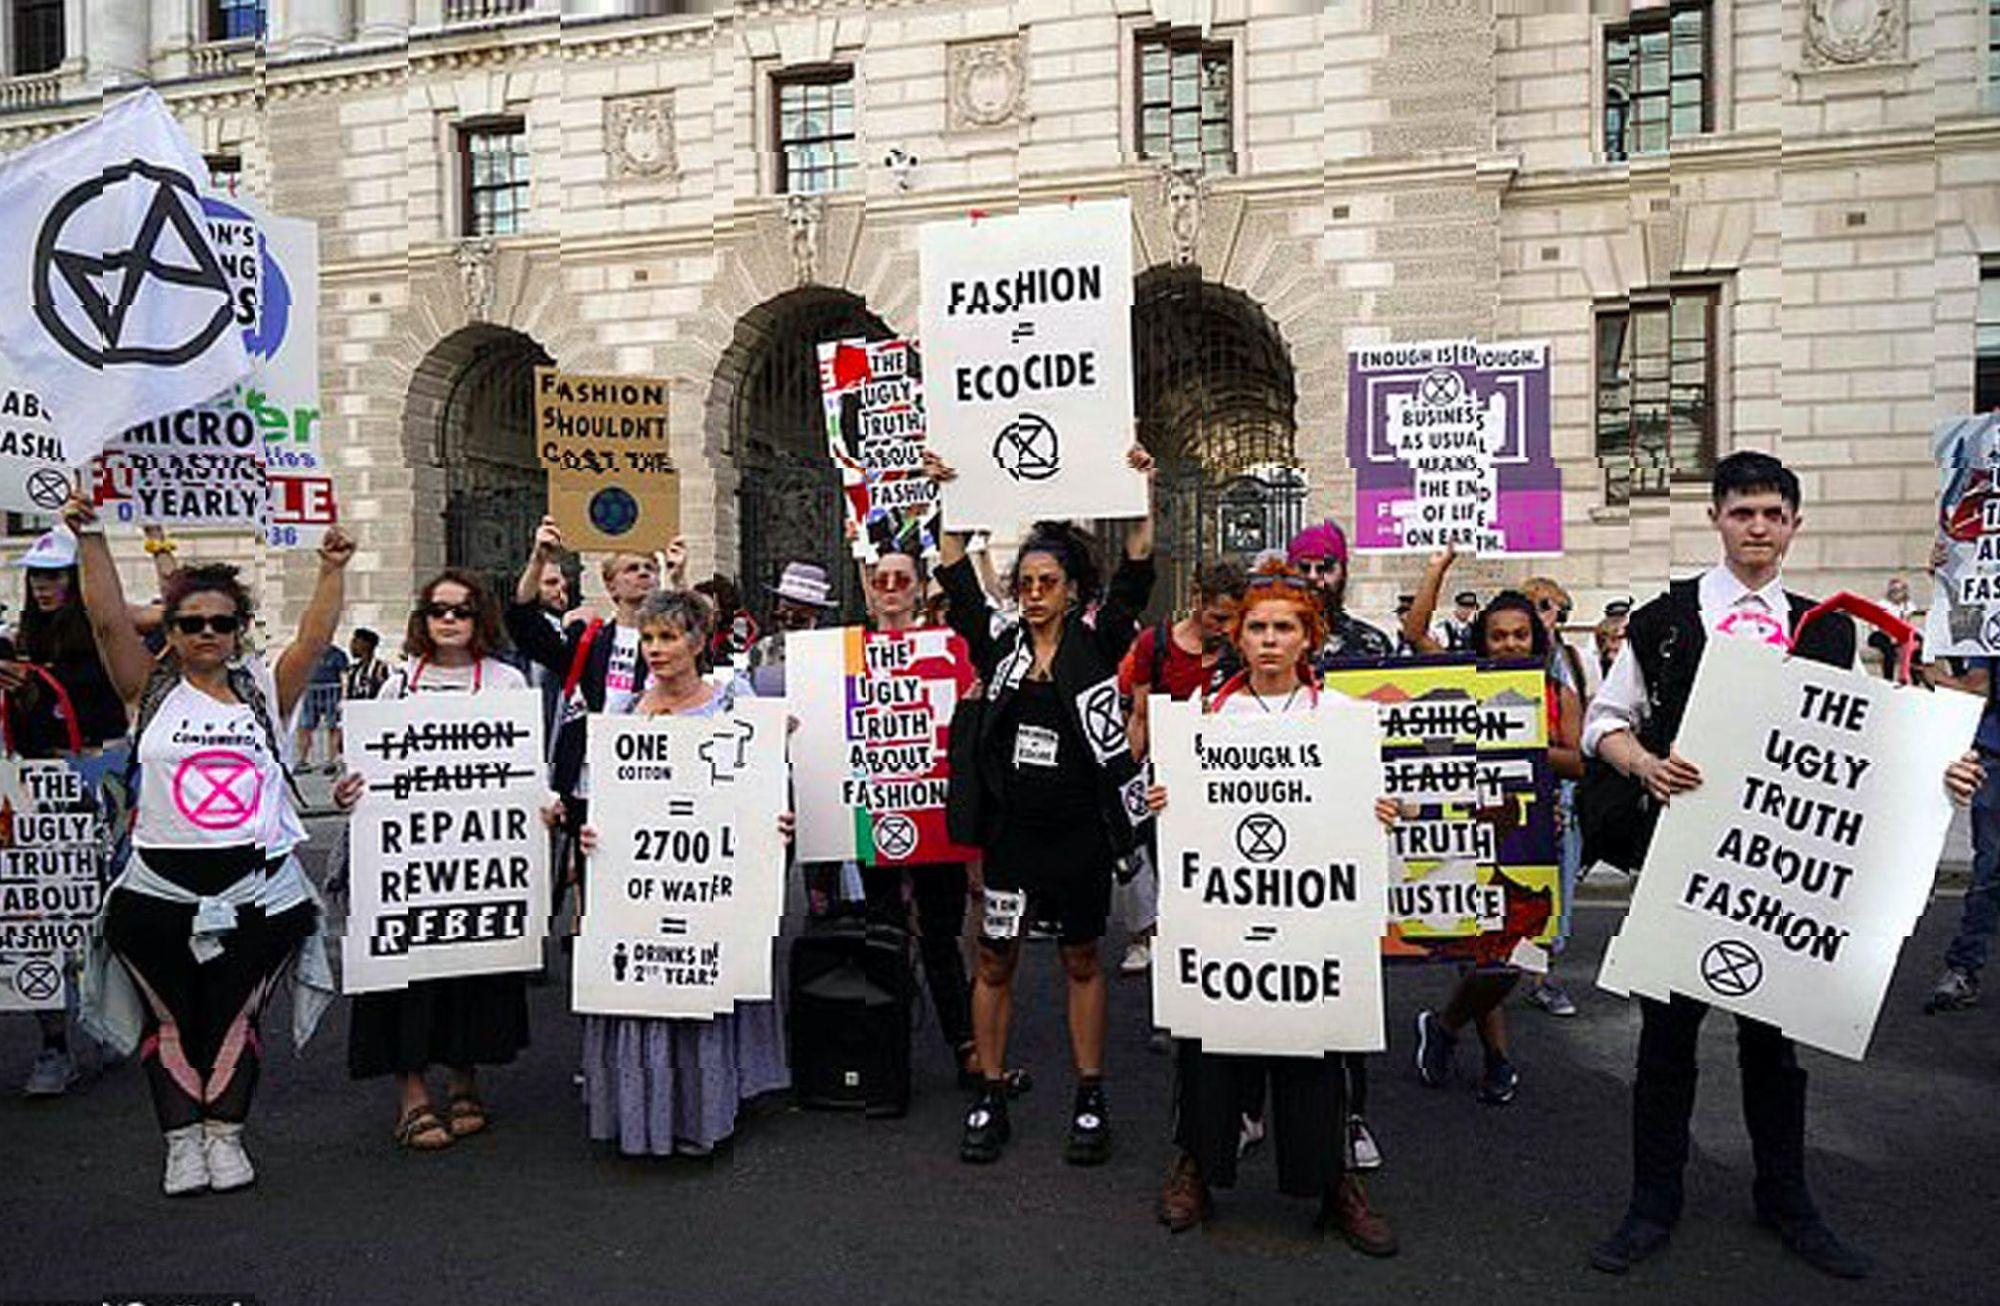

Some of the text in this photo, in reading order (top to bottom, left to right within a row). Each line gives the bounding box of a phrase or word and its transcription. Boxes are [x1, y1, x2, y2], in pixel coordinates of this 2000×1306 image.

[949, 265, 1101, 315] FASHION
[872, 353, 903, 371] THE
[1361, 350, 1432, 367] ENOUGH
[541, 374, 663, 405] FASHION
[957, 352, 1095, 401] ECOCIDE
[2, 391, 52, 421] AB
[860, 385, 911, 407] UGLY
[123, 409, 254, 447] MICRO
[543, 407, 668, 440] SHOULDNT
[1402, 406, 1485, 431] BUSINESS
[1401, 431, 1487, 454] AS USUAL
[543, 442, 675, 474] COST THE
[1417, 456, 1485, 479] MEANS
[870, 480, 941, 506] FASHIO
[1420, 481, 1449, 498] THE
[1423, 503, 1486, 528] OF LIFE
[1406, 528, 1434, 546] ON
[868, 644, 909, 668] THE
[860, 677, 918, 705] UGLY
[1386, 704, 1507, 741] ASHION
[1800, 684, 1870, 732] THE
[855, 710, 928, 739] TRUTH
[382, 721, 514, 759] FASHION
[615, 734, 668, 761] ONE
[1195, 733, 1322, 770] ENOUGH IS
[617, 766, 672, 780] COTTON
[851, 745, 931, 774] ABOUT
[1765, 729, 1872, 790] UGLY
[30, 775, 77, 798] THE
[394, 762, 510, 799] BEAUTY
[843, 780, 944, 810] FASHION
[1207, 781, 1313, 804] ENOUGH.
[1742, 777, 1864, 847] TRUTH
[19, 816, 88, 842] UGLY
[382, 808, 527, 853] REPAIR
[1393, 822, 1491, 860] TRUTH
[634, 830, 710, 863] 2700
[7, 849, 92, 875] TRUTH
[1716, 828, 1853, 900] ABOUT
[382, 857, 529, 902] REWEAR
[628, 875, 733, 903] OF WATER
[1181, 852, 1357, 909] FASHION
[4, 885, 94, 911] ABOUT
[377, 904, 521, 953] REBEL
[1684, 872, 1851, 963] FASHION
[1179, 947, 1341, 1005] ECOCIDE
